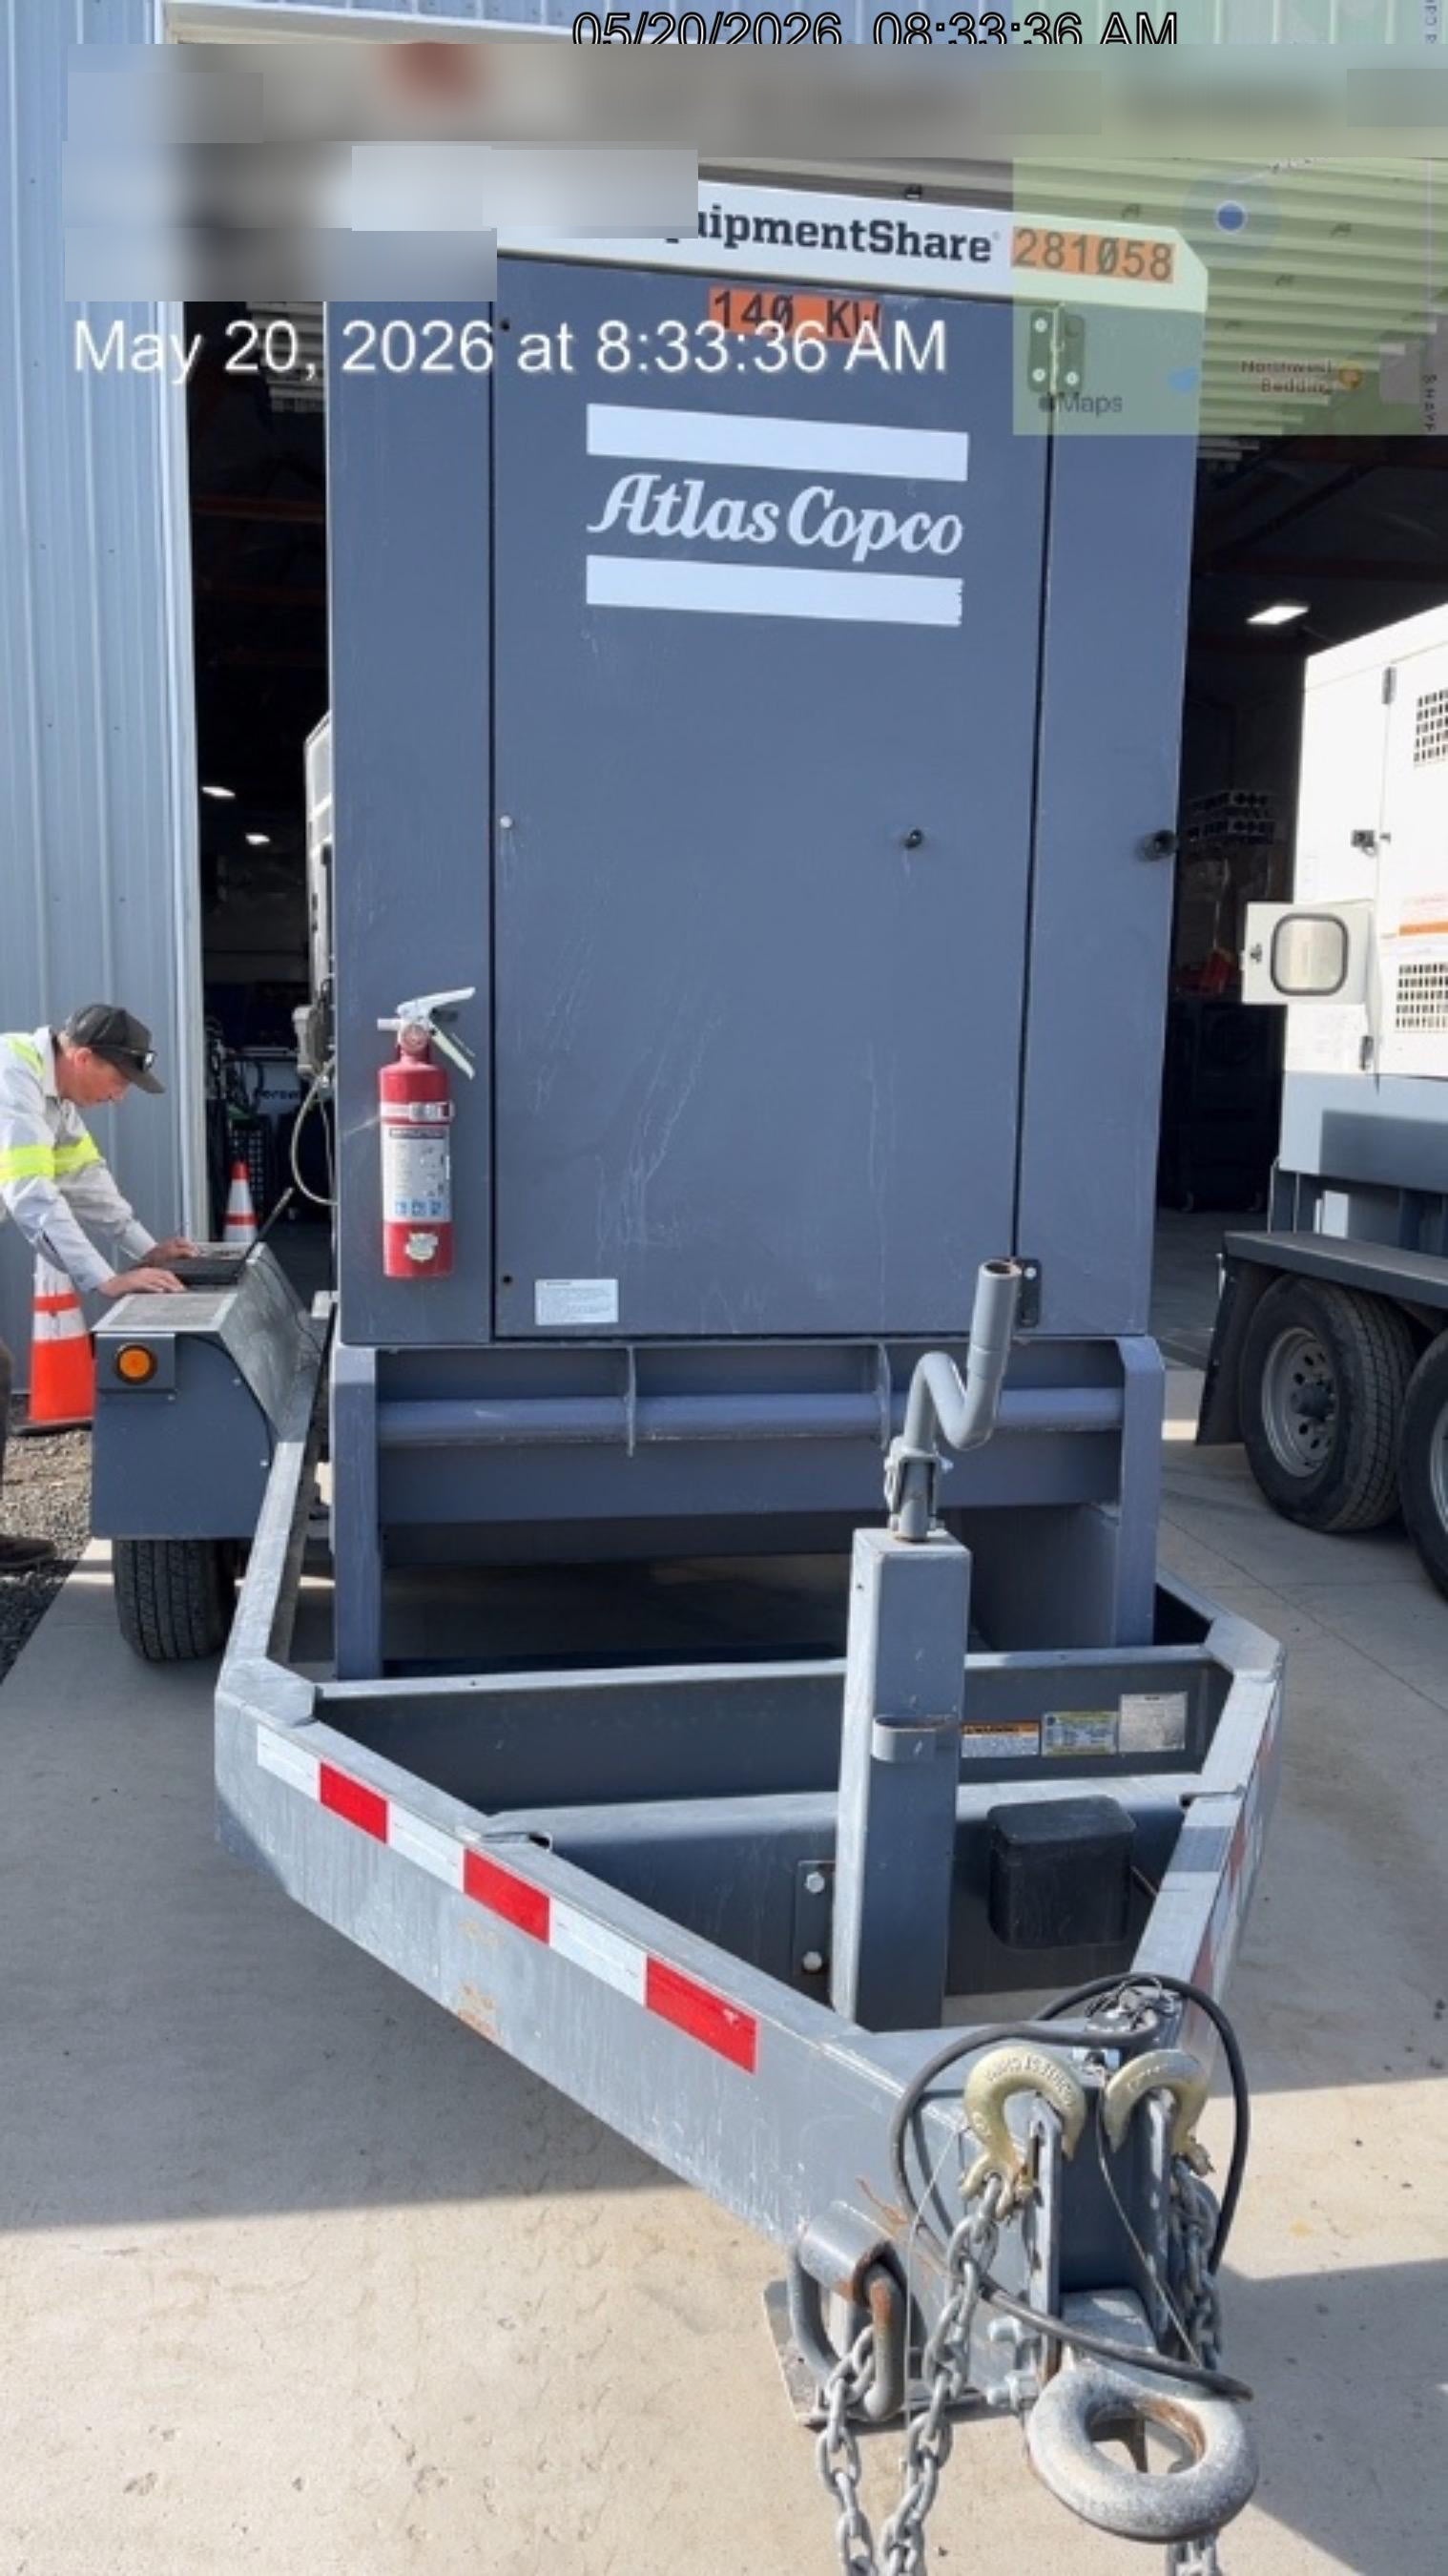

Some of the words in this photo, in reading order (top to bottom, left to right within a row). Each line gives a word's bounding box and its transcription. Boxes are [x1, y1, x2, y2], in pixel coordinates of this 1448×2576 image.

[666, 202, 993, 263] ipmentShare
[1014, 227, 1174, 280] 281058
[586, 471, 780, 544] Atlas
[787, 485, 965, 563] Copco
